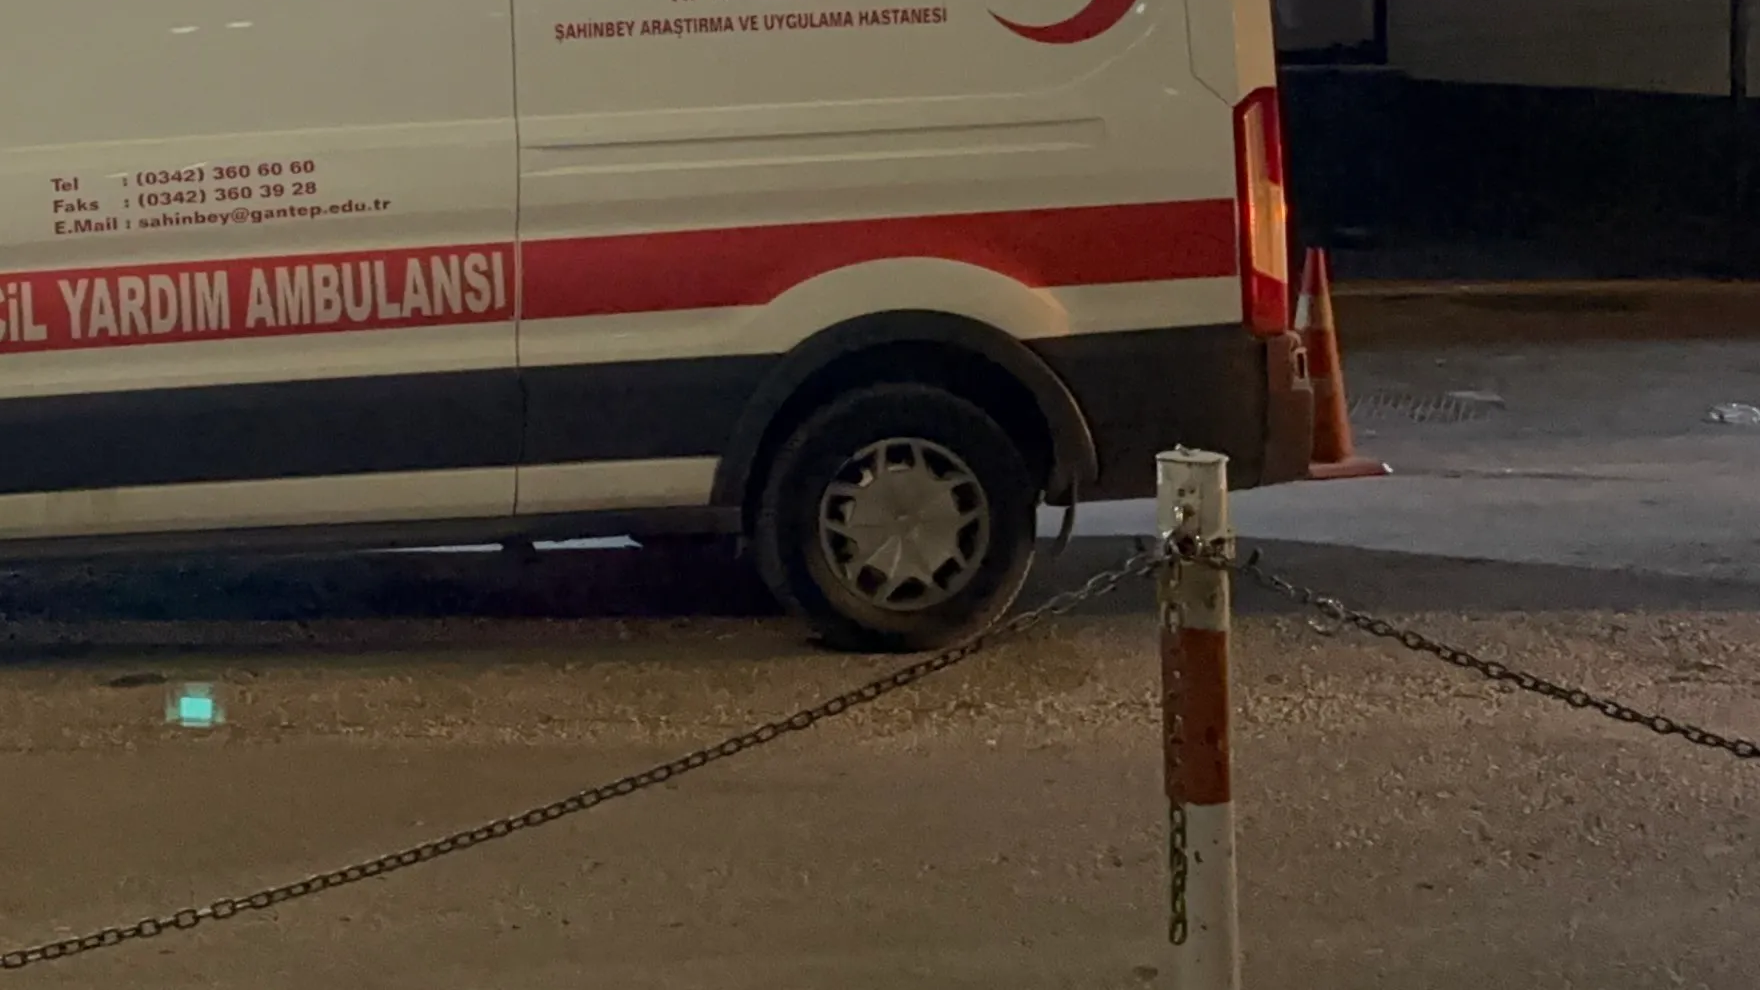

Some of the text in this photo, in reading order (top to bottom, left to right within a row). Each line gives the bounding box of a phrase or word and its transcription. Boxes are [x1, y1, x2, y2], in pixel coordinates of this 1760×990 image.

[554, 18, 636, 44] ŞAHİNBEY
[640, 15, 735, 39] ARAŞTIRMA
[738, 14, 759, 32] VE
[764, 10, 854, 31] UYGULAMA
[51, 177, 79, 192] Tel
[136, 168, 205, 187] (0342)
[212, 165, 251, 180] 360
[257, 162, 283, 177] 60
[289, 160, 315, 174] 60
[53, 198, 100, 213] Faks
[138, 189, 206, 208] (0342)
[214, 186, 253, 201] 360
[259, 184, 285, 198] 39
[291, 181, 317, 196] 28
[54, 217, 118, 235] E.Mail
[138, 198, 391, 229] sahinbey@gantep.edu.tr
[57, 270, 231, 339] YARDIM
[245, 251, 506, 329] AMBULANSI
